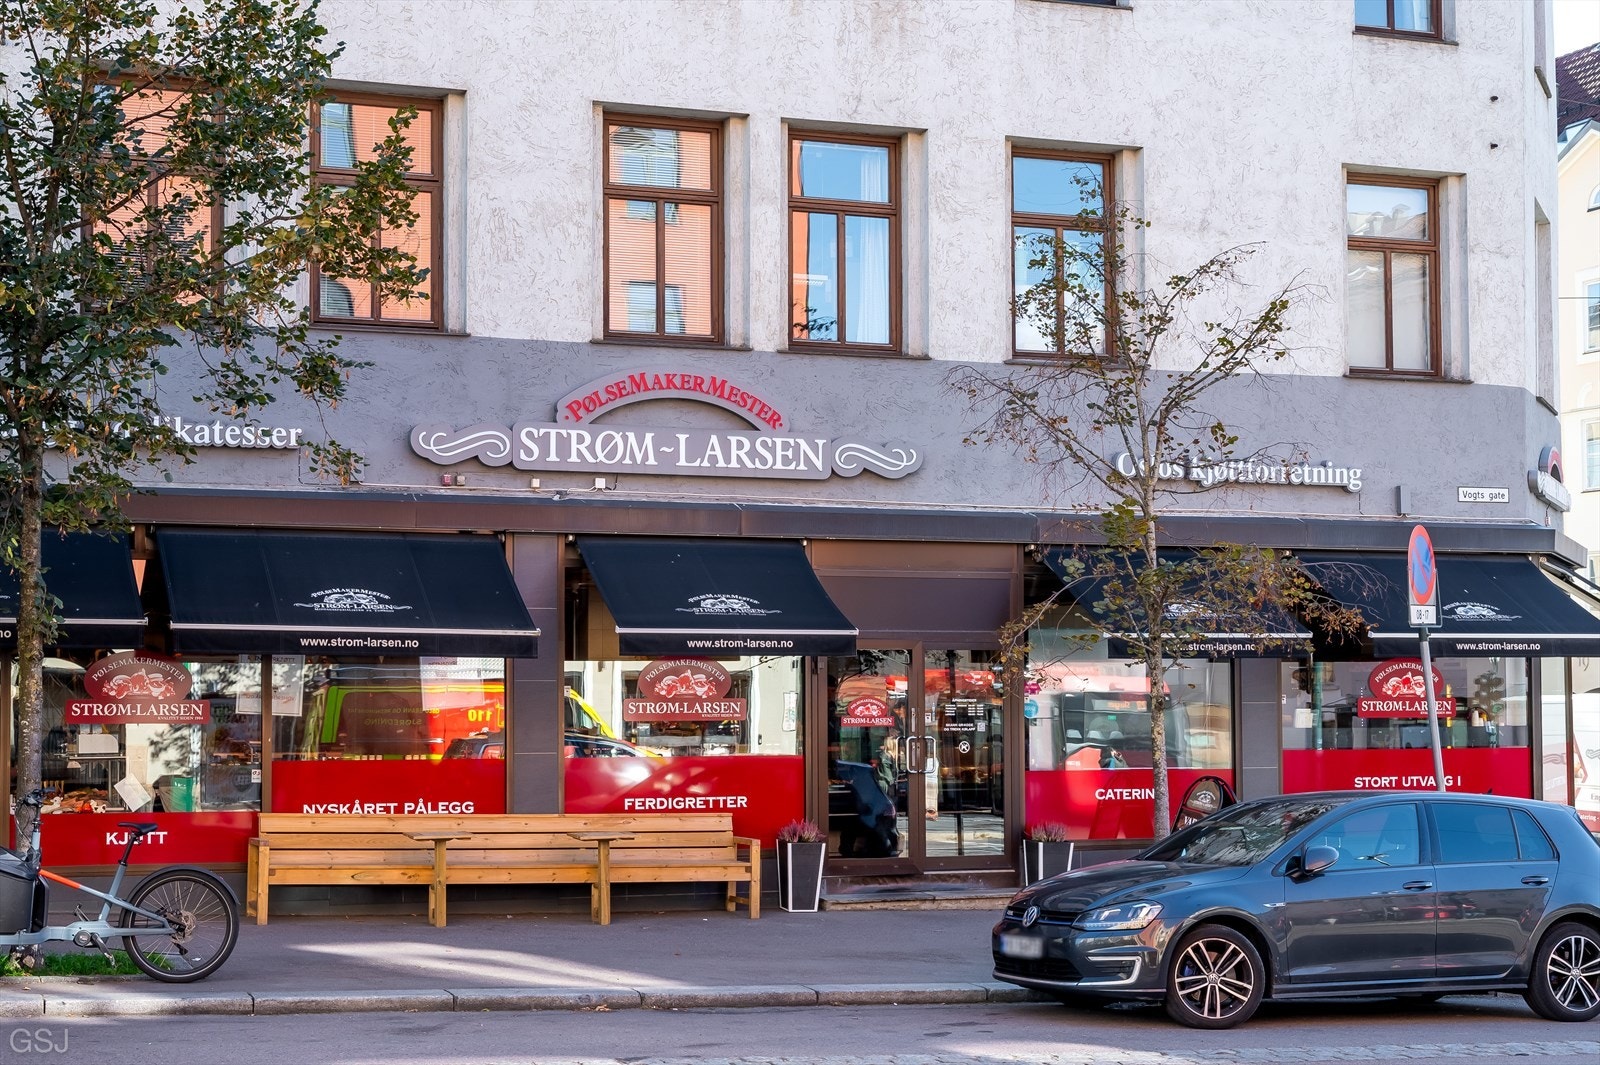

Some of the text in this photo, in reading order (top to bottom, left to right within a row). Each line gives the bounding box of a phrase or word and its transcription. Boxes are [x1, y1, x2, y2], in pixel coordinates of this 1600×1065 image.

[1462, 490, 1506, 501] Vogts gate
[300, 637, 419, 648] www.strom-larsen.no
[687, 638, 793, 648] www.strom-larsen.no
[1456, 641, 1541, 651] www.strom-larsen.no
[91, 656, 187, 682] PØLSEMAKERMESTER
[645, 659, 726, 682] PØLSEMAKERMESTER
[71, 703, 204, 716] STRØM-LARSEN
[628, 702, 741, 714] STRØM-LARSEN
[1361, 700, 1451, 711] STRØM-LAREN
[1354, 776, 1398, 788] STORT
[1402, 775, 1453, 787] UTVAG
[1094, 788, 1156, 800] CATERIN
[303, 798, 475, 814] NYSKÅRET PÅLEGG
[624, 796, 748, 810] FERDIGRETTER
